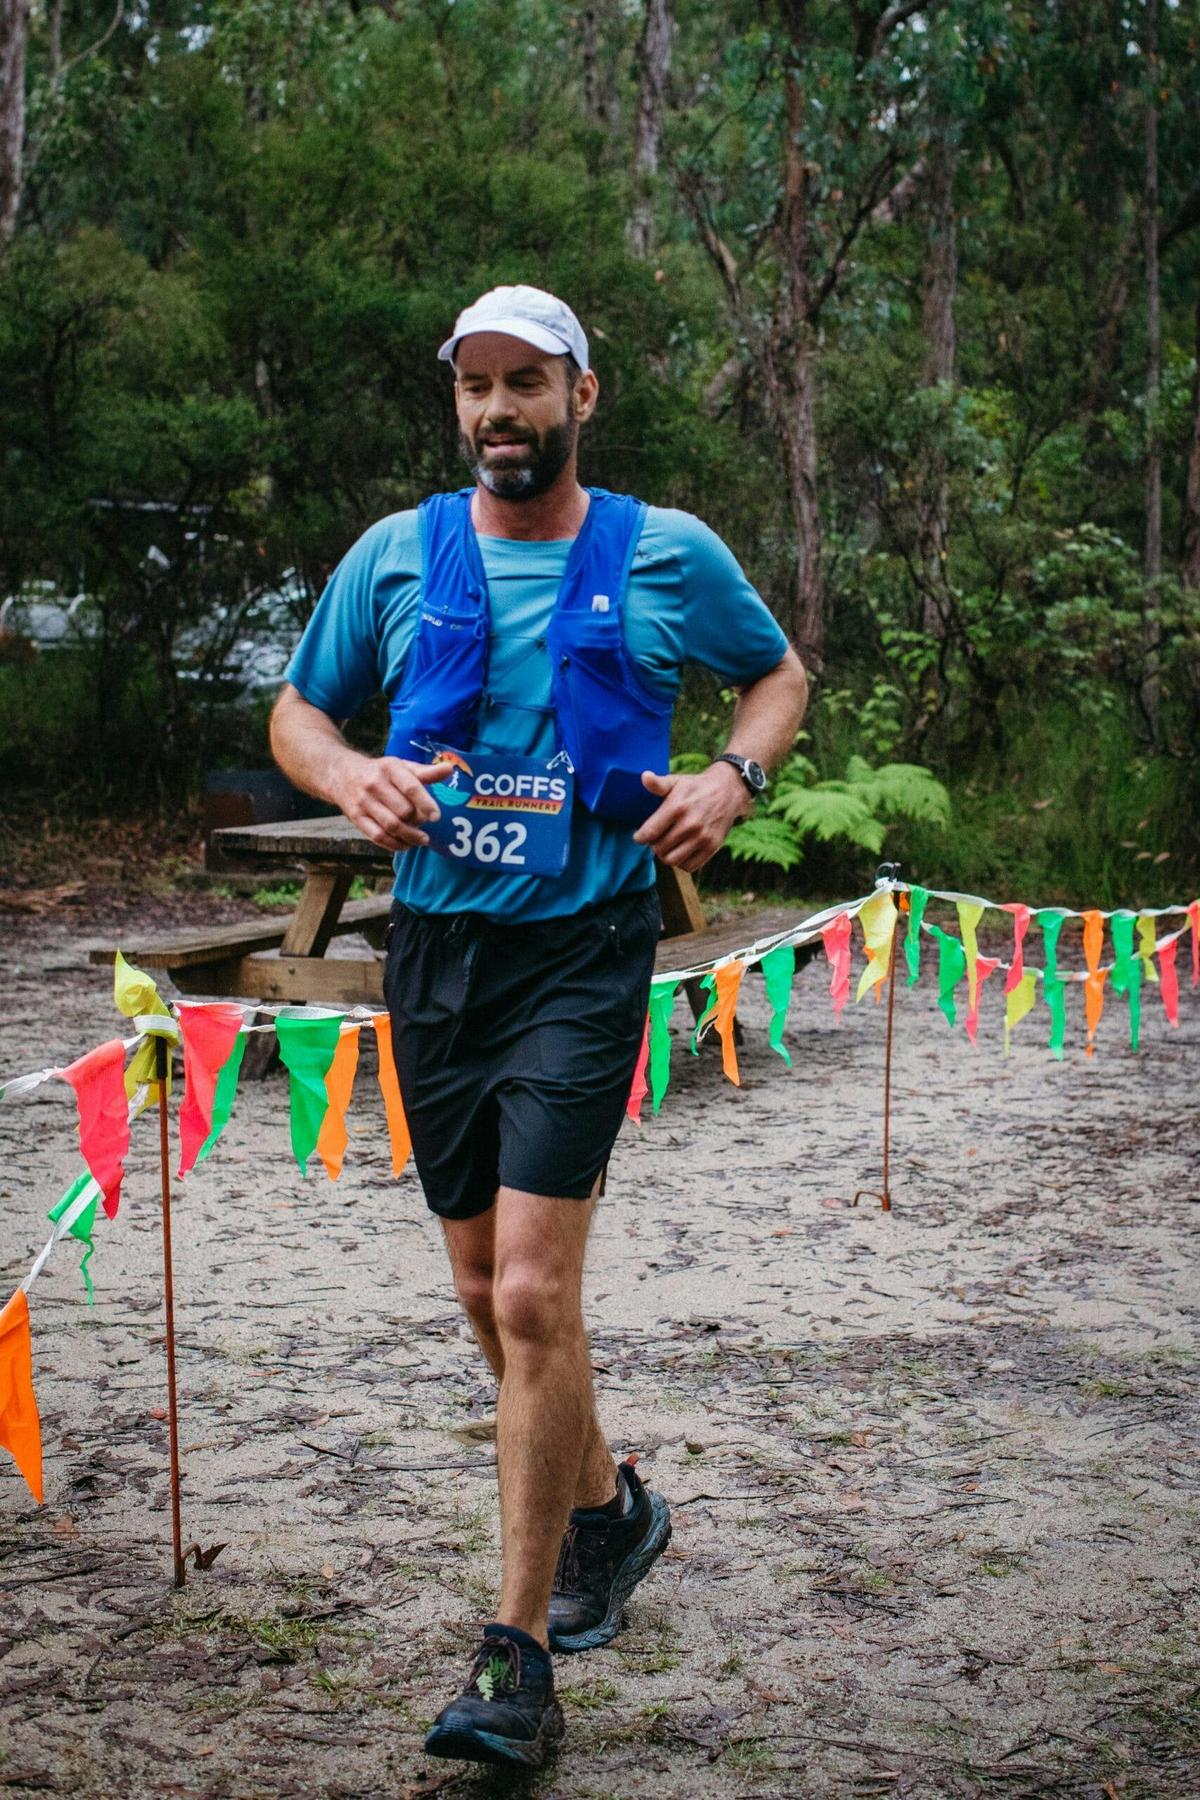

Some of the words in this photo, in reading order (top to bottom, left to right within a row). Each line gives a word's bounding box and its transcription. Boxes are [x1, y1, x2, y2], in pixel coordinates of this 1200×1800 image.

[474, 773, 566, 801] COFFS
[475, 798, 504, 807] TRAIL
[507, 799, 558, 812] RUNNERS
[448, 816, 528, 865] 362
